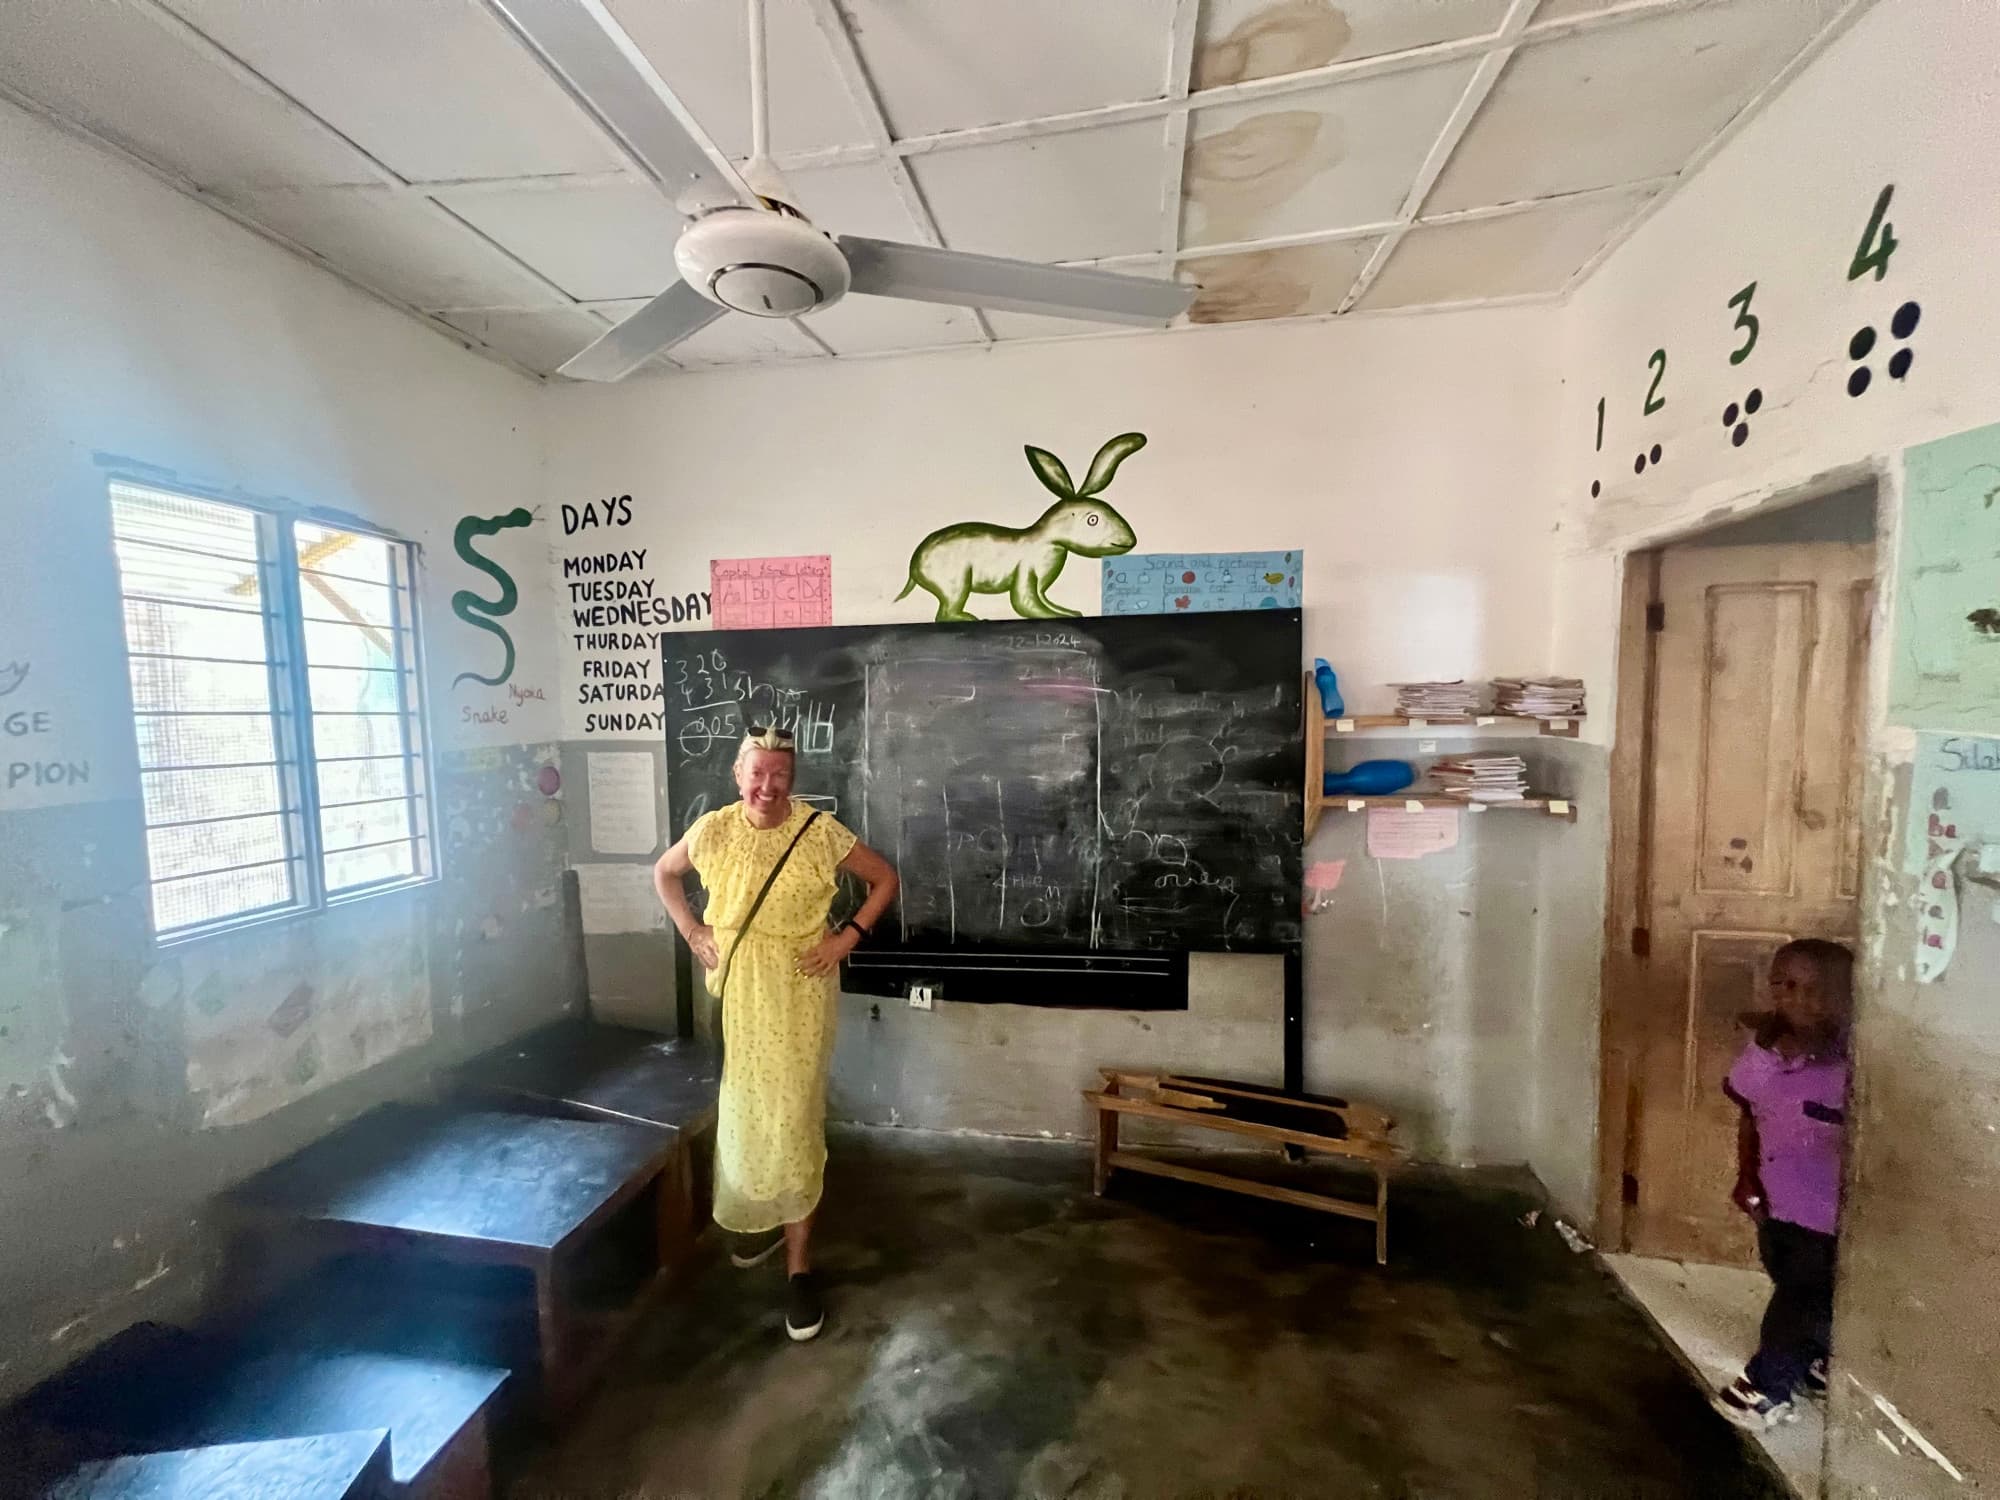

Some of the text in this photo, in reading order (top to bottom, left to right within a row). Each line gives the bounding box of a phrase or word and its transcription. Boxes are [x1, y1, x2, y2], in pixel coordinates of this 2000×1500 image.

[1847, 184, 1899, 282] 4
[1727, 281, 1760, 366] 3
[1643, 348, 1667, 417] 2
[1596, 397, 1605, 452] 1
[561, 495, 633, 535] DAYS
[563, 548, 647, 578] MONDAY
[568, 578, 655, 603] TUESDAY
[573, 592, 712, 627] WEDNESDAY
[573, 632, 660, 651] THURDAY
[583, 659, 651, 680] FRIDAY
[578, 683, 665, 704] SATURDA
[462, 704, 508, 725] Snake
[585, 711, 665, 733] SUNDAY
